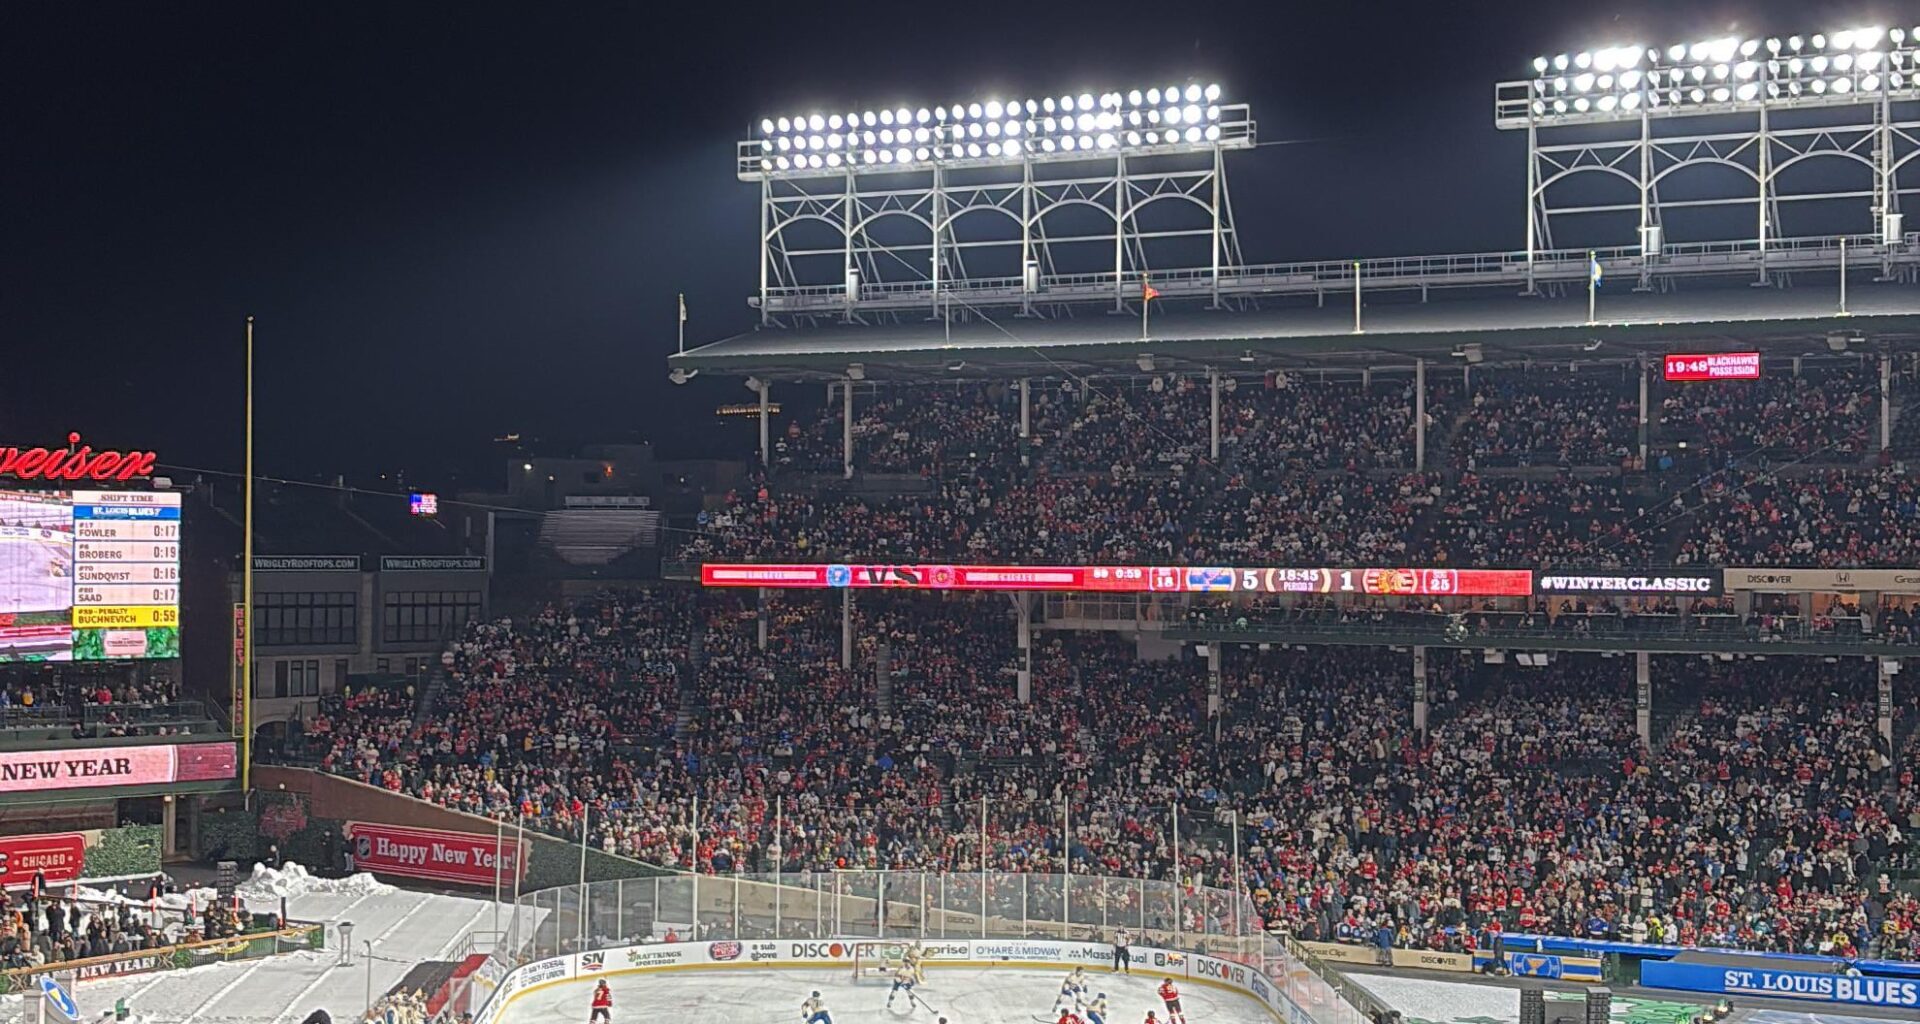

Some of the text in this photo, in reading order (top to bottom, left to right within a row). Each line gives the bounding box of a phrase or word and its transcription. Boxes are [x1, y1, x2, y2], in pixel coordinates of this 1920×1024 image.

[1667, 361, 1707, 372] 19:48
[1707, 356, 1759, 366] BLACKHAWKS
[1709, 366, 1756, 376] POSSESSION
[79, 529, 116, 537] FOWLER
[154, 525, 176, 537] 0:17
[79, 551, 122, 559] BROBERG
[154, 546, 176, 558] 0:19
[79, 572, 130, 581] SUNDQVIST
[153, 567, 176, 579] 0:16
[866, 567, 919, 585] VS
[1278, 569, 1319, 581] 18:45
[1747, 575, 1792, 583] DISCOVER
[1156, 576, 1174, 588] 18
[1242, 570, 1258, 589] 5
[1340, 571, 1354, 590] 1
[1430, 578, 1450, 590] 25
[1540, 576, 1711, 592] #WINTERCLASSIC
[79, 594, 102, 602] SAAD
[153, 588, 175, 600] 0:17
[78, 615, 137, 624] BUCHNEVICH
[153, 610, 175, 622] 0:59
[1, 757, 132, 781] NEW YEAR
[376, 837, 516, 870] Happy New Year!
[22, 853, 65, 868] CHICAGO
[760, 941, 776, 950] sub
[792, 943, 875, 957] DISCOVER
[976, 946, 1013, 955] O'HARE
[1022, 946, 1062, 956] MIDWAY
[581, 951, 606, 966] SN
[751, 951, 777, 961] above
[1421, 955, 1457, 965] DISCOVER
[81, 963, 111, 978] NEW
[1197, 958, 1245, 984] DISCOVER
[1724, 970, 1917, 1004] ST. LOUIS BLUES
